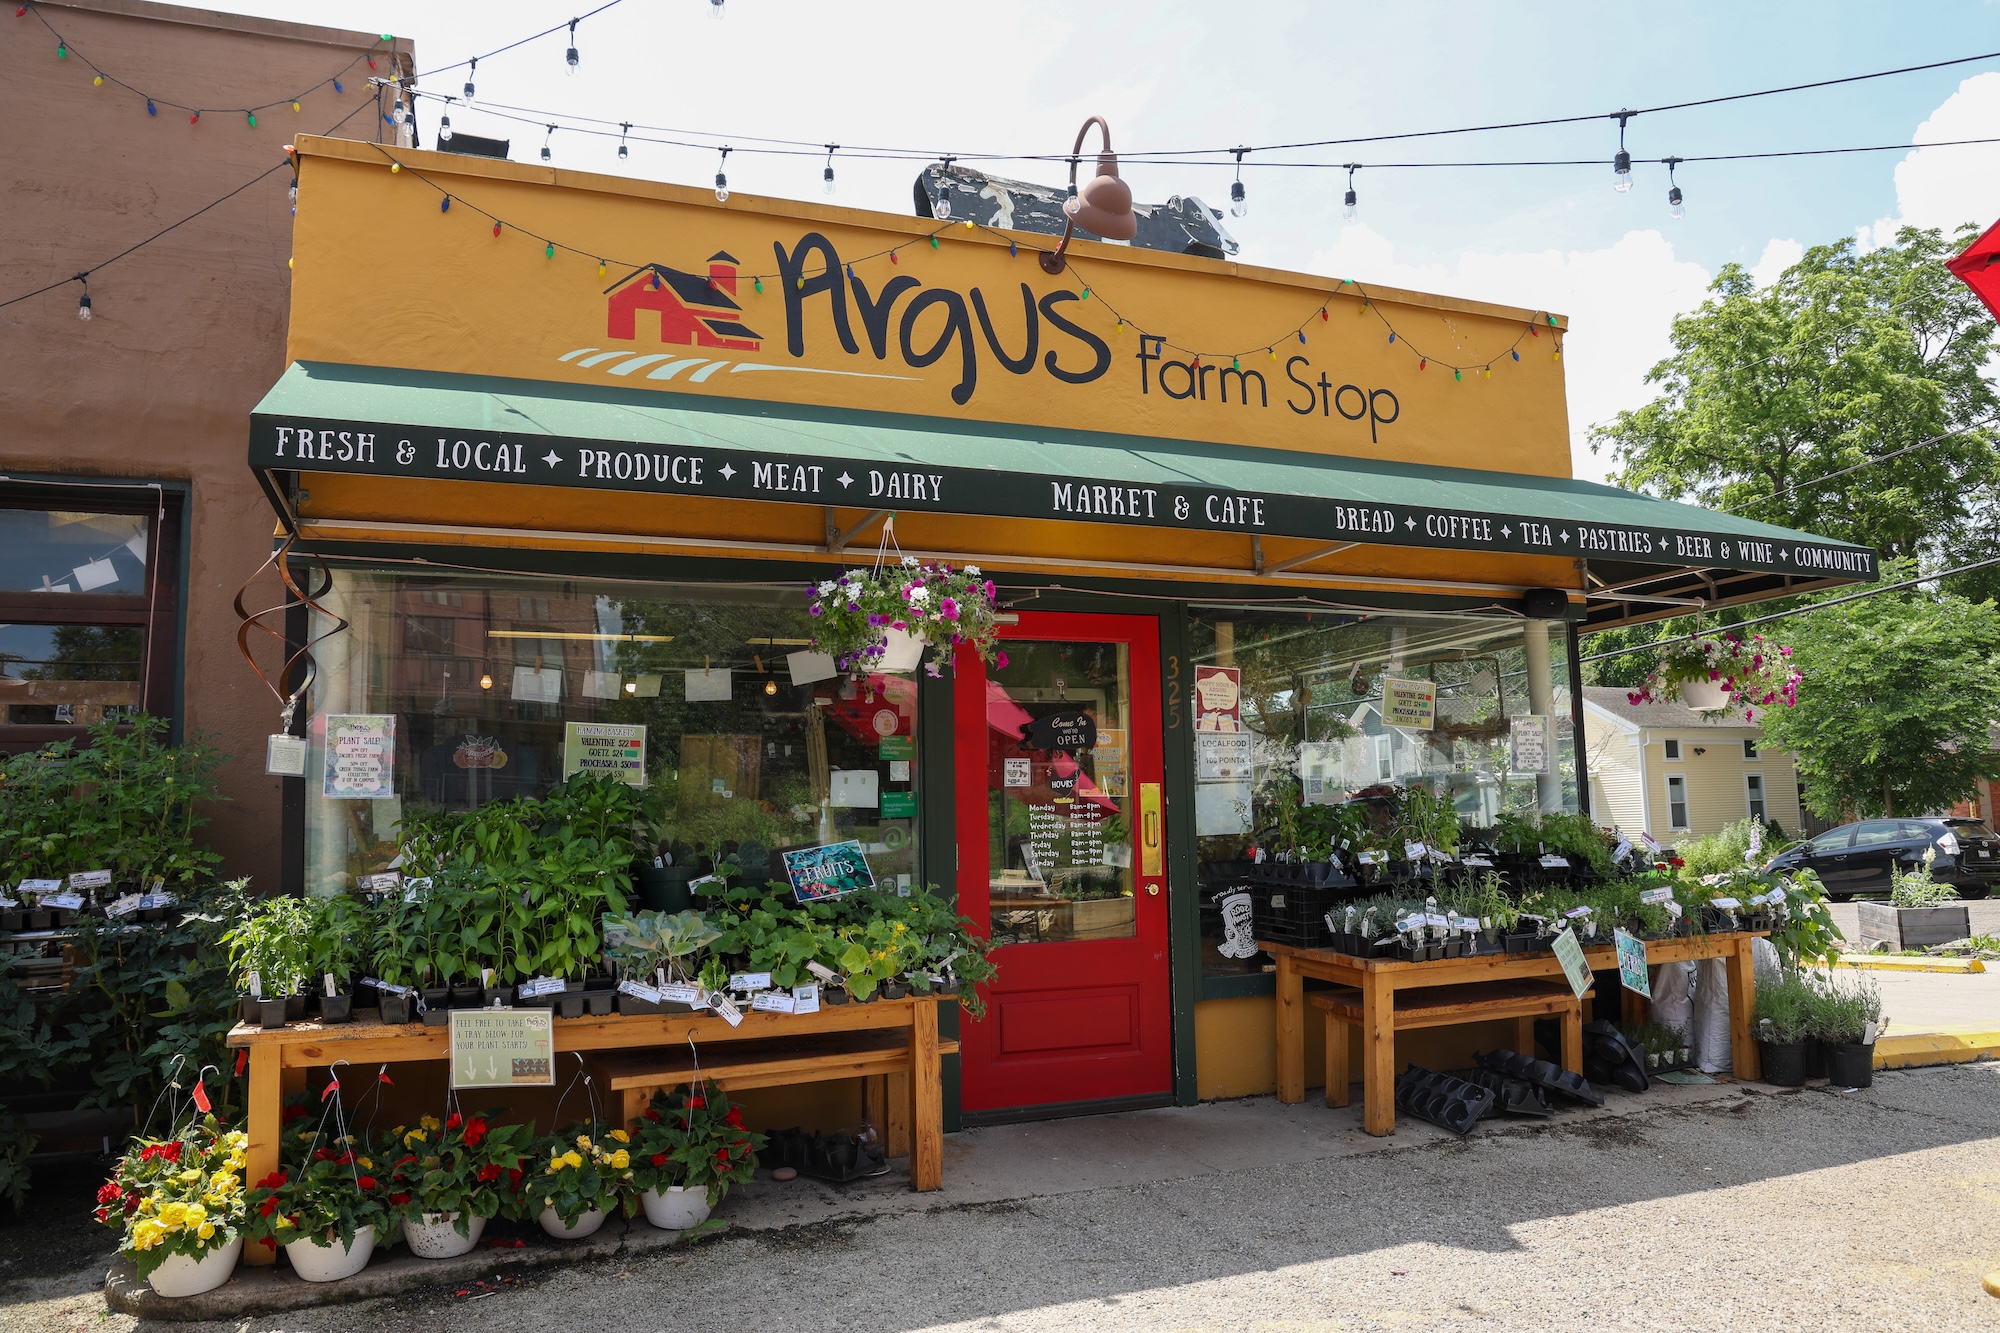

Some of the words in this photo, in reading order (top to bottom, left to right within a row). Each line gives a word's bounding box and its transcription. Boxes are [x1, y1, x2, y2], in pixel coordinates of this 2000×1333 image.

[774, 231, 1111, 405] Argus
[1136, 333, 1267, 408] Farm
[1286, 356, 1400, 444] Stop
[275, 426, 375, 462] FRESH
[396, 440, 415, 465] &
[436, 438, 525, 473] LOCAL
[578, 449, 703, 485] PRODUCE
[751, 461, 824, 493] MEAT
[868, 470, 943, 502] DAIRY
[1051, 481, 1157, 518] MARKET
[1173, 495, 1190, 521] &
[1205, 494, 1265, 526] CAFE
[1335, 506, 1395, 533] BREAD
[1425, 514, 1493, 541] COFFEE
[1519, 522, 1553, 546] TEA
[1577, 527, 1652, 554] PASTRIES
[1675, 535, 1713, 559] BEER
[1720, 541, 1731, 560] &
[1737, 540, 1774, 564] WINE
[1794, 546, 1871, 573] COMMUNITY
[1167, 655, 1181, 729] 325
[1052, 717, 1074, 728] Come
[1077, 716, 1088, 727] In
[339, 736, 360, 745] PLANT
[582, 738, 616, 747] VALENTINE
[1057, 734, 1086, 746] OPEN
[588, 748, 610, 756] GOETZ
[580, 759, 618, 768] PROCHASKA
[1052, 780, 1074, 788] HOURS
[1029, 804, 1055, 812] Monday
[1030, 822, 1065, 830] Wednesday
[804, 860, 854, 881] FRUITS
[1031, 859, 1054, 867] Sunday
[1211, 886, 1235, 903] proudly
[526, 1016, 546, 1027] Argus
[486, 1030, 507, 1038] BELOW
[456, 1041, 474, 1049] YOUR
[478, 1041, 496, 1049] PLANT
